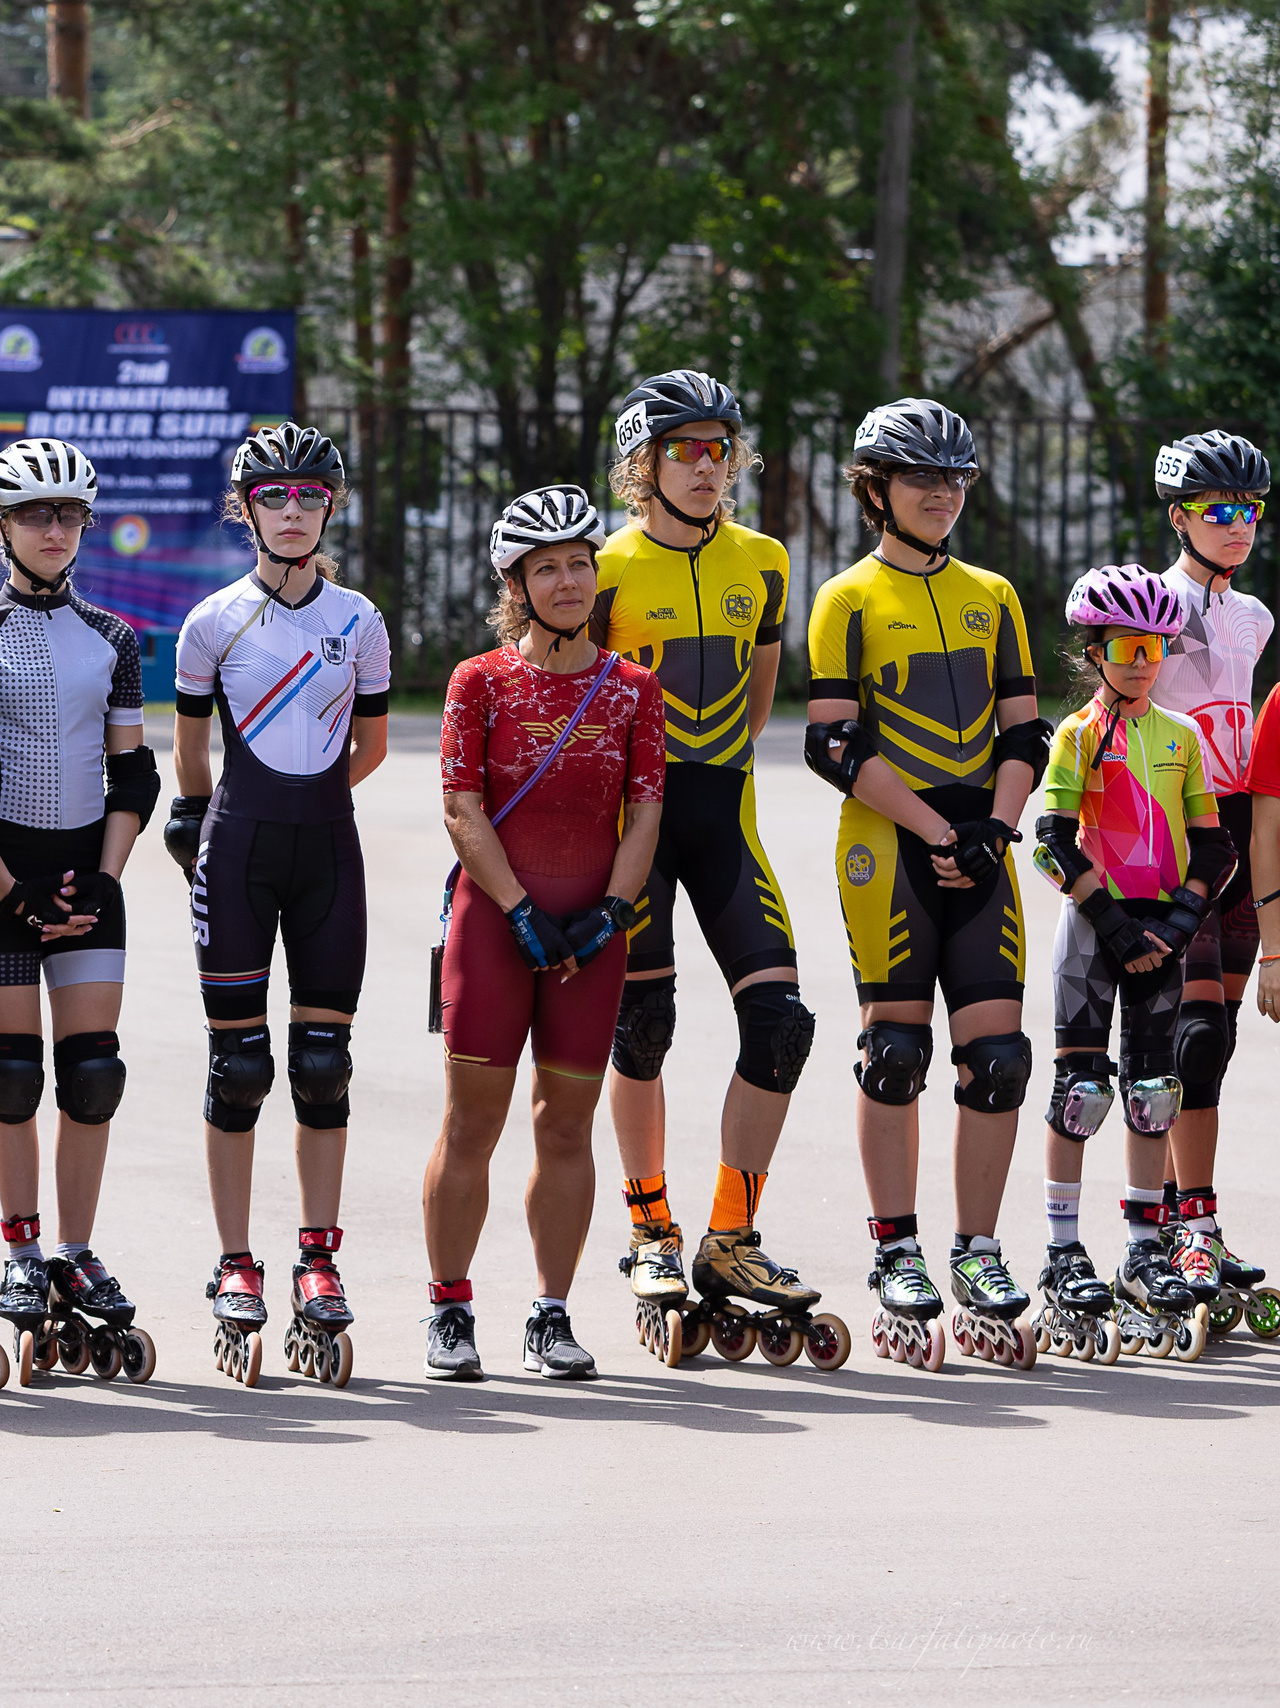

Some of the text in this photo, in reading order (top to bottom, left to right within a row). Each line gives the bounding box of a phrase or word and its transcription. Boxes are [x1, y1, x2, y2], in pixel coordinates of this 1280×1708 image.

[46, 386, 228, 411] INTERNATIONAL
[26, 411, 250, 440] ROLLER SURF
[619, 412, 642, 446] 656
